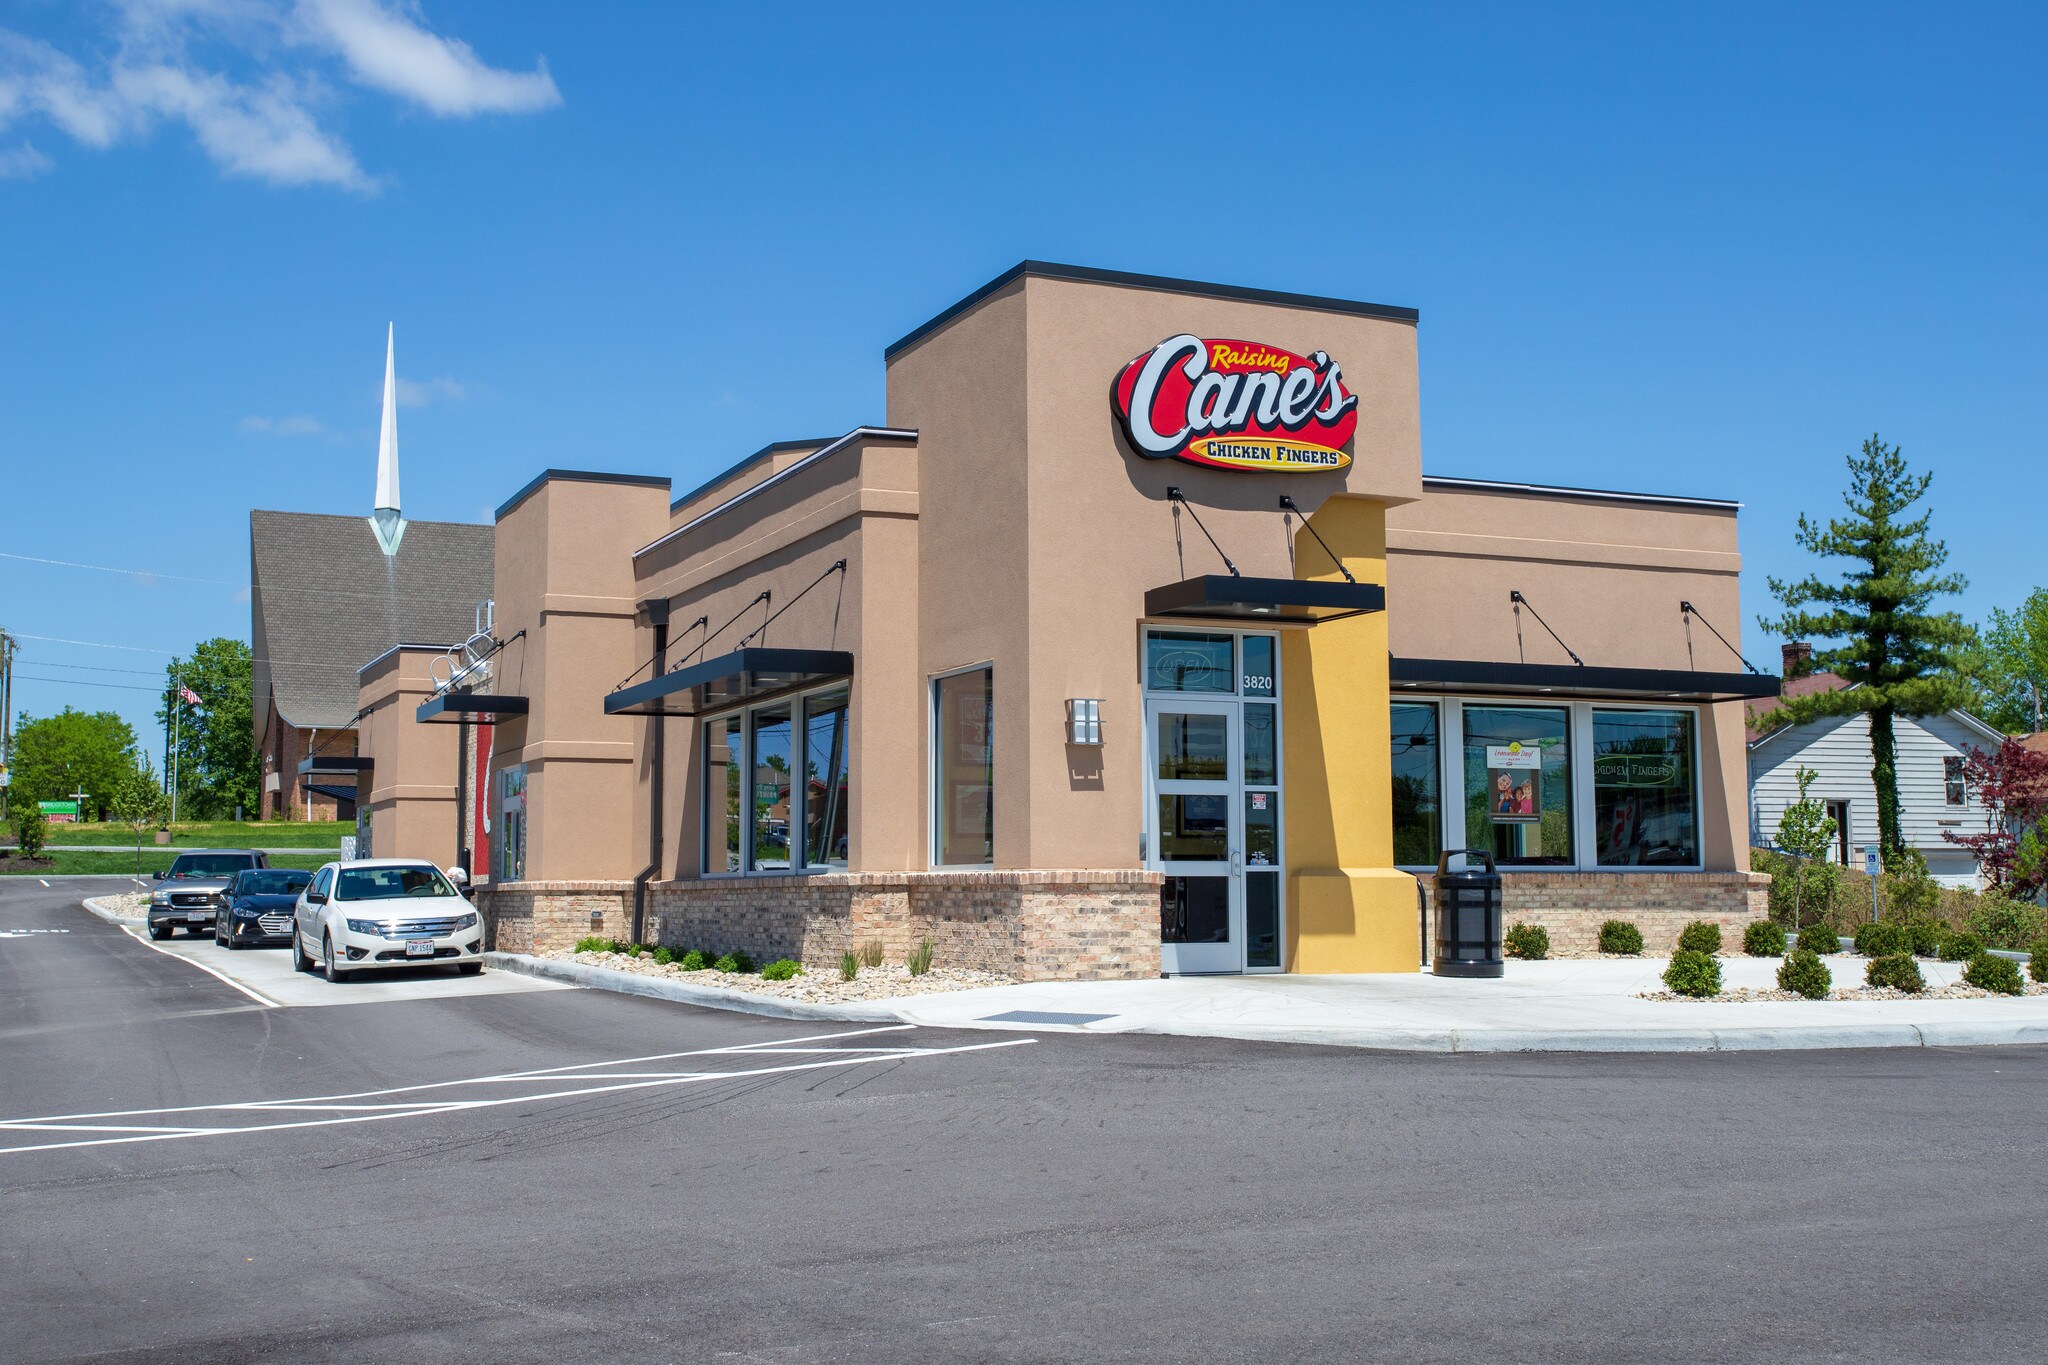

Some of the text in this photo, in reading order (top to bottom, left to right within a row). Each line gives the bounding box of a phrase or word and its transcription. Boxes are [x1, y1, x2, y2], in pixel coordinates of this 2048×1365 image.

[1211, 344, 1290, 375] Raising
[1130, 333, 1358, 452] Cane's
[1207, 441, 1338, 465] CHICKEN FINGERS
[1162, 659, 1206, 673] OPEN
[1243, 675, 1272, 689] 3820
